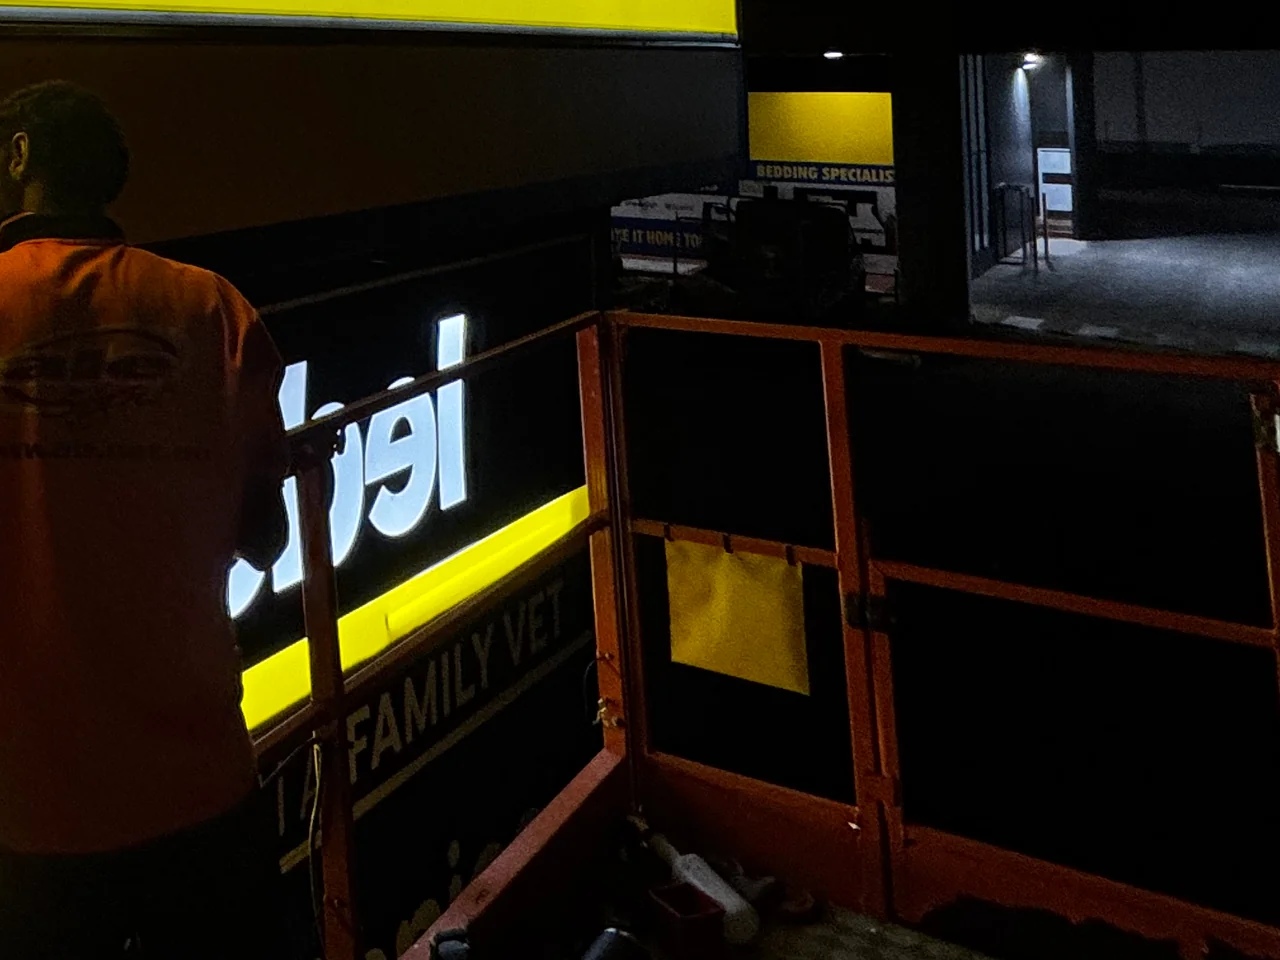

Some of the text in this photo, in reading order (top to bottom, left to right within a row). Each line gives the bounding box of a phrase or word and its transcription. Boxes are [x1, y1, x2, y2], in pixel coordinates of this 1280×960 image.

[756, 164, 819, 180] BEDDING
[345, 620, 496, 786] FAMILY
[503, 577, 564, 668] VET
